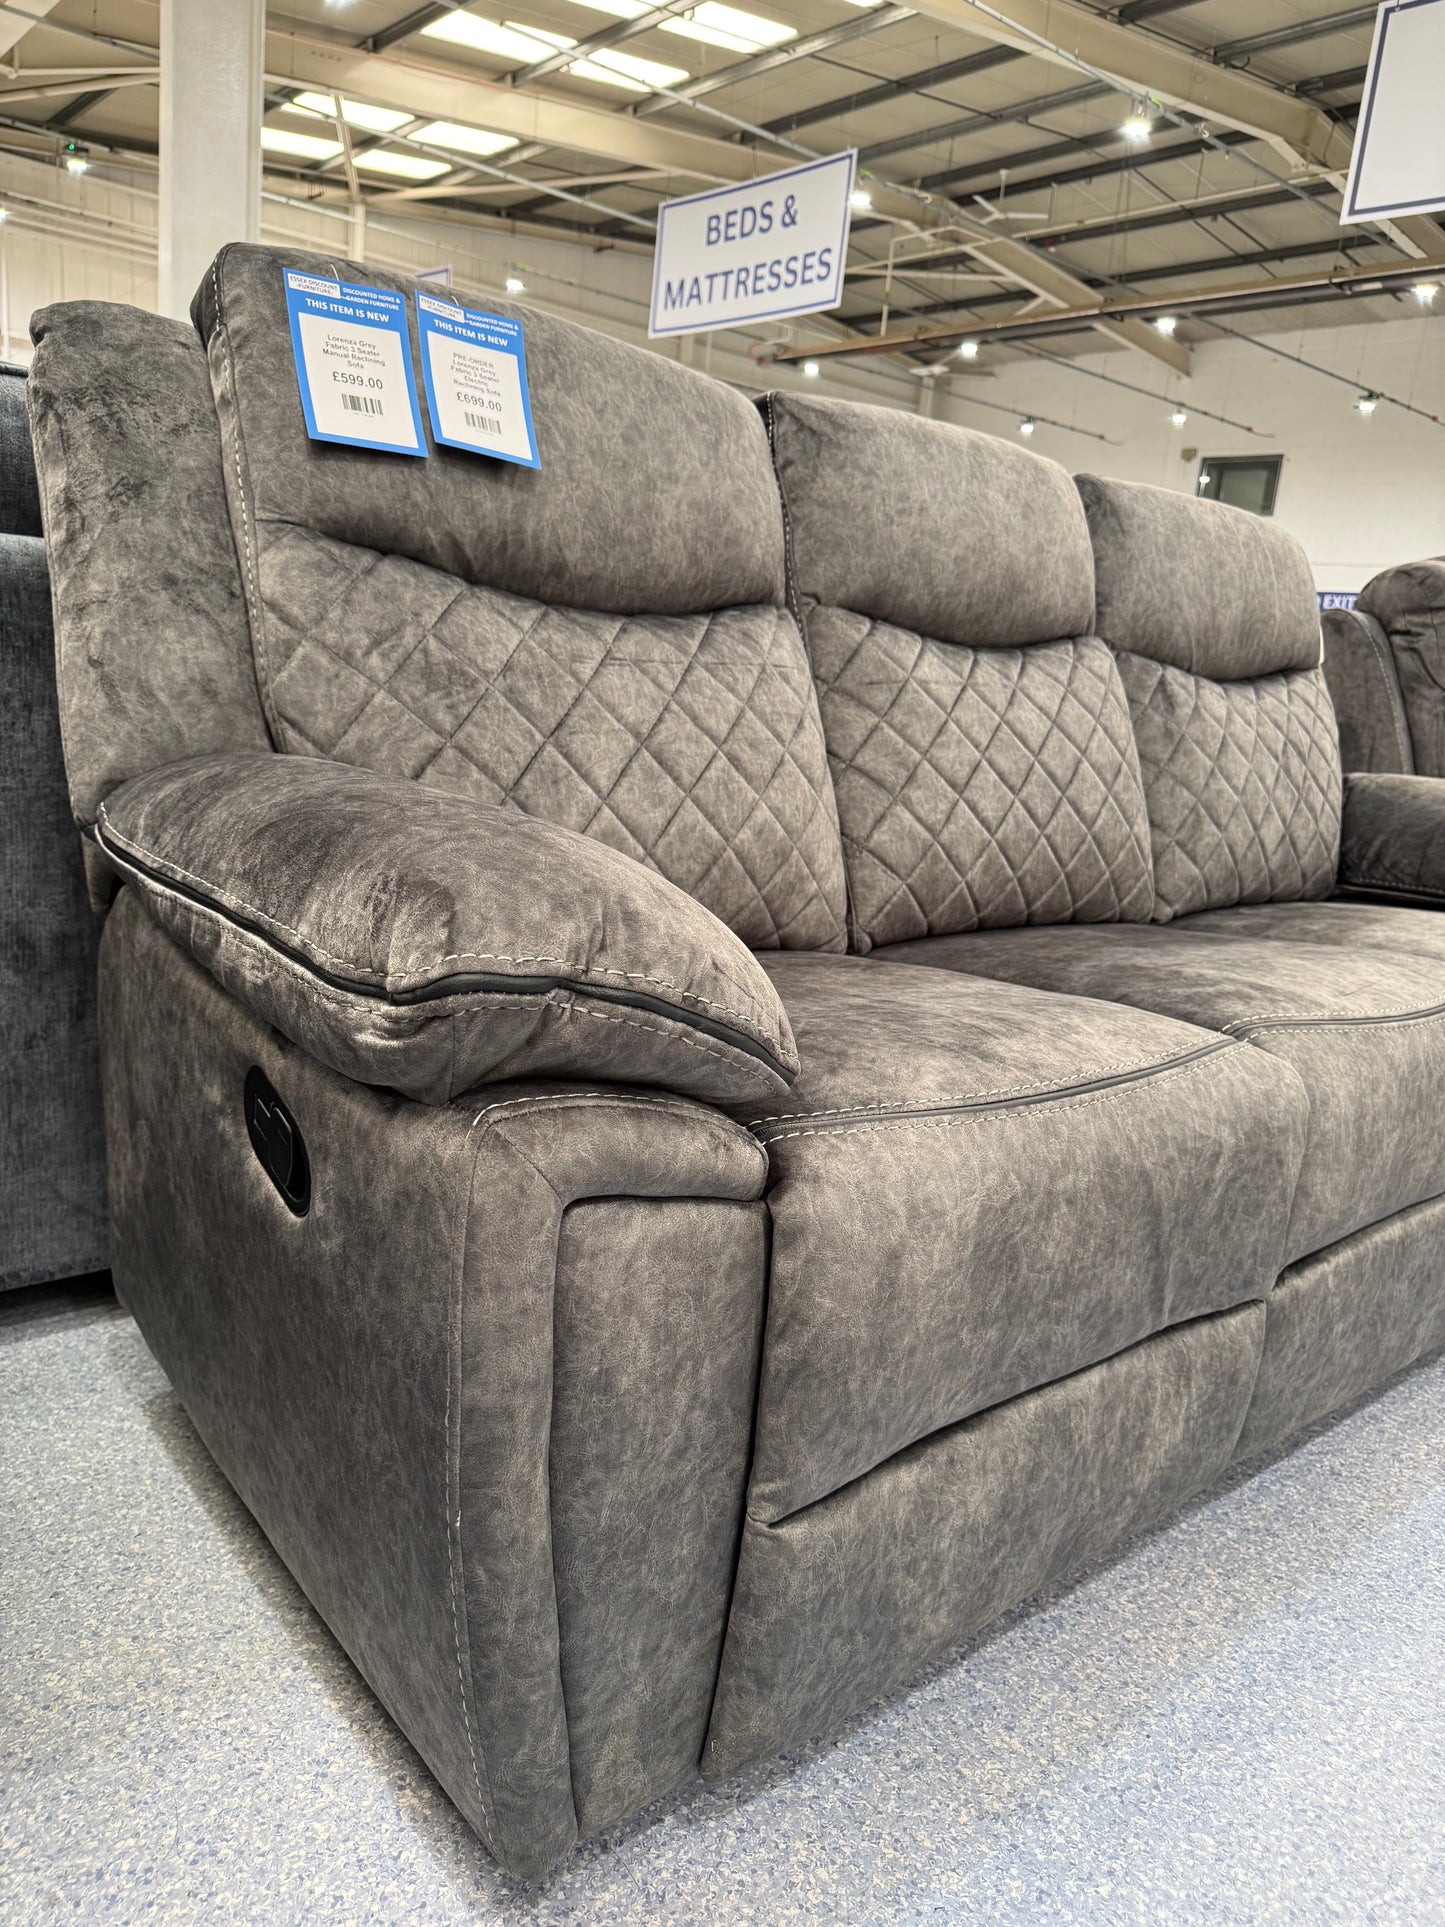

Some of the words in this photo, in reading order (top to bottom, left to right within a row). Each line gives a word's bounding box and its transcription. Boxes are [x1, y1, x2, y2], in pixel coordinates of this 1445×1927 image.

[705, 200, 774, 247] BEDS
[781, 194, 798, 228] &
[290, 275, 307, 284] ESSEX
[308, 279, 337, 291] DISCOUNT
[664, 248, 832, 311] MATTRESSES
[343, 287, 377, 299] DISCOUNTED
[378, 295, 395, 303] HOME
[346, 295, 369, 305] GARDEN
[370, 301, 399, 311] FURNITURE
[305, 298, 327, 310] THIS
[330, 303, 354, 316] ITEM
[356, 309, 365, 318] IS
[367, 312, 389, 322] NEW
[466, 313, 498, 325] DISCOUNTED
[433, 319, 453, 332] THIS
[455, 326, 476, 339] ITEM
[477, 332, 486, 341] IS
[487, 335, 509, 347] NEW
[325, 341, 349, 352] Fabric
[357, 347, 380, 357] Seater
[327, 334, 357, 346] Lorenza
[359, 340, 376, 350] Grey
[322, 348, 350, 359] Manual
[351, 353, 386, 367] Reclining
[347, 360, 364, 369] Sofa
[332, 371, 383, 389] £599.00
[456, 391, 502, 412] £699.00
